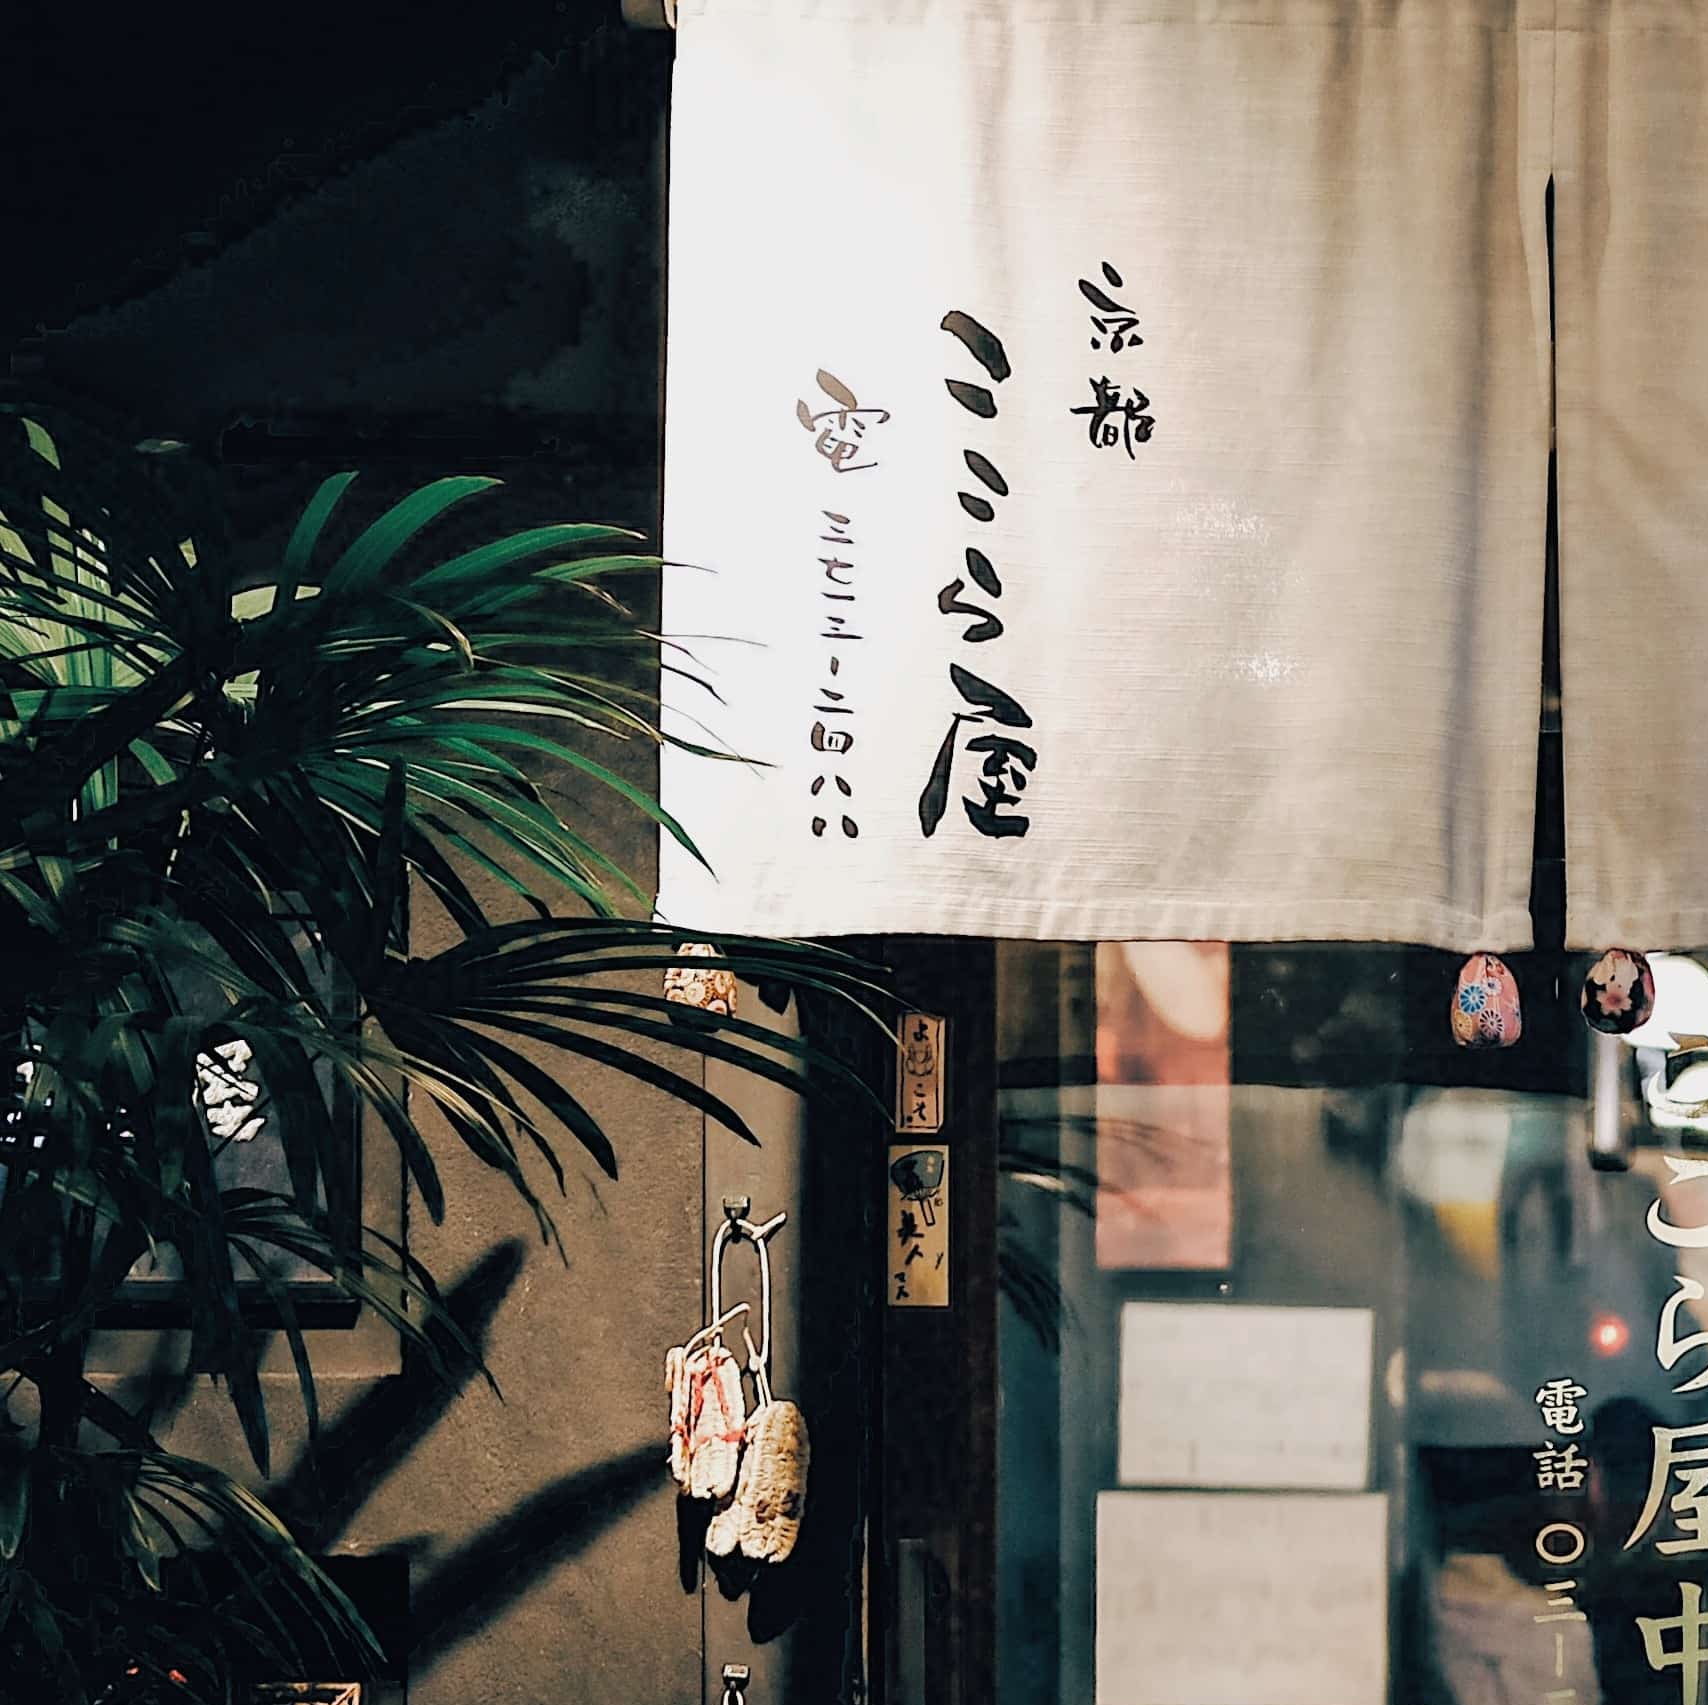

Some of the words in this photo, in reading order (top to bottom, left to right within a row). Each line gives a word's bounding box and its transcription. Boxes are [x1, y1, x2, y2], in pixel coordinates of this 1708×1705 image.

[1070, 262, 1155, 460] 京都
[918, 311, 1037, 838] ここら屋
